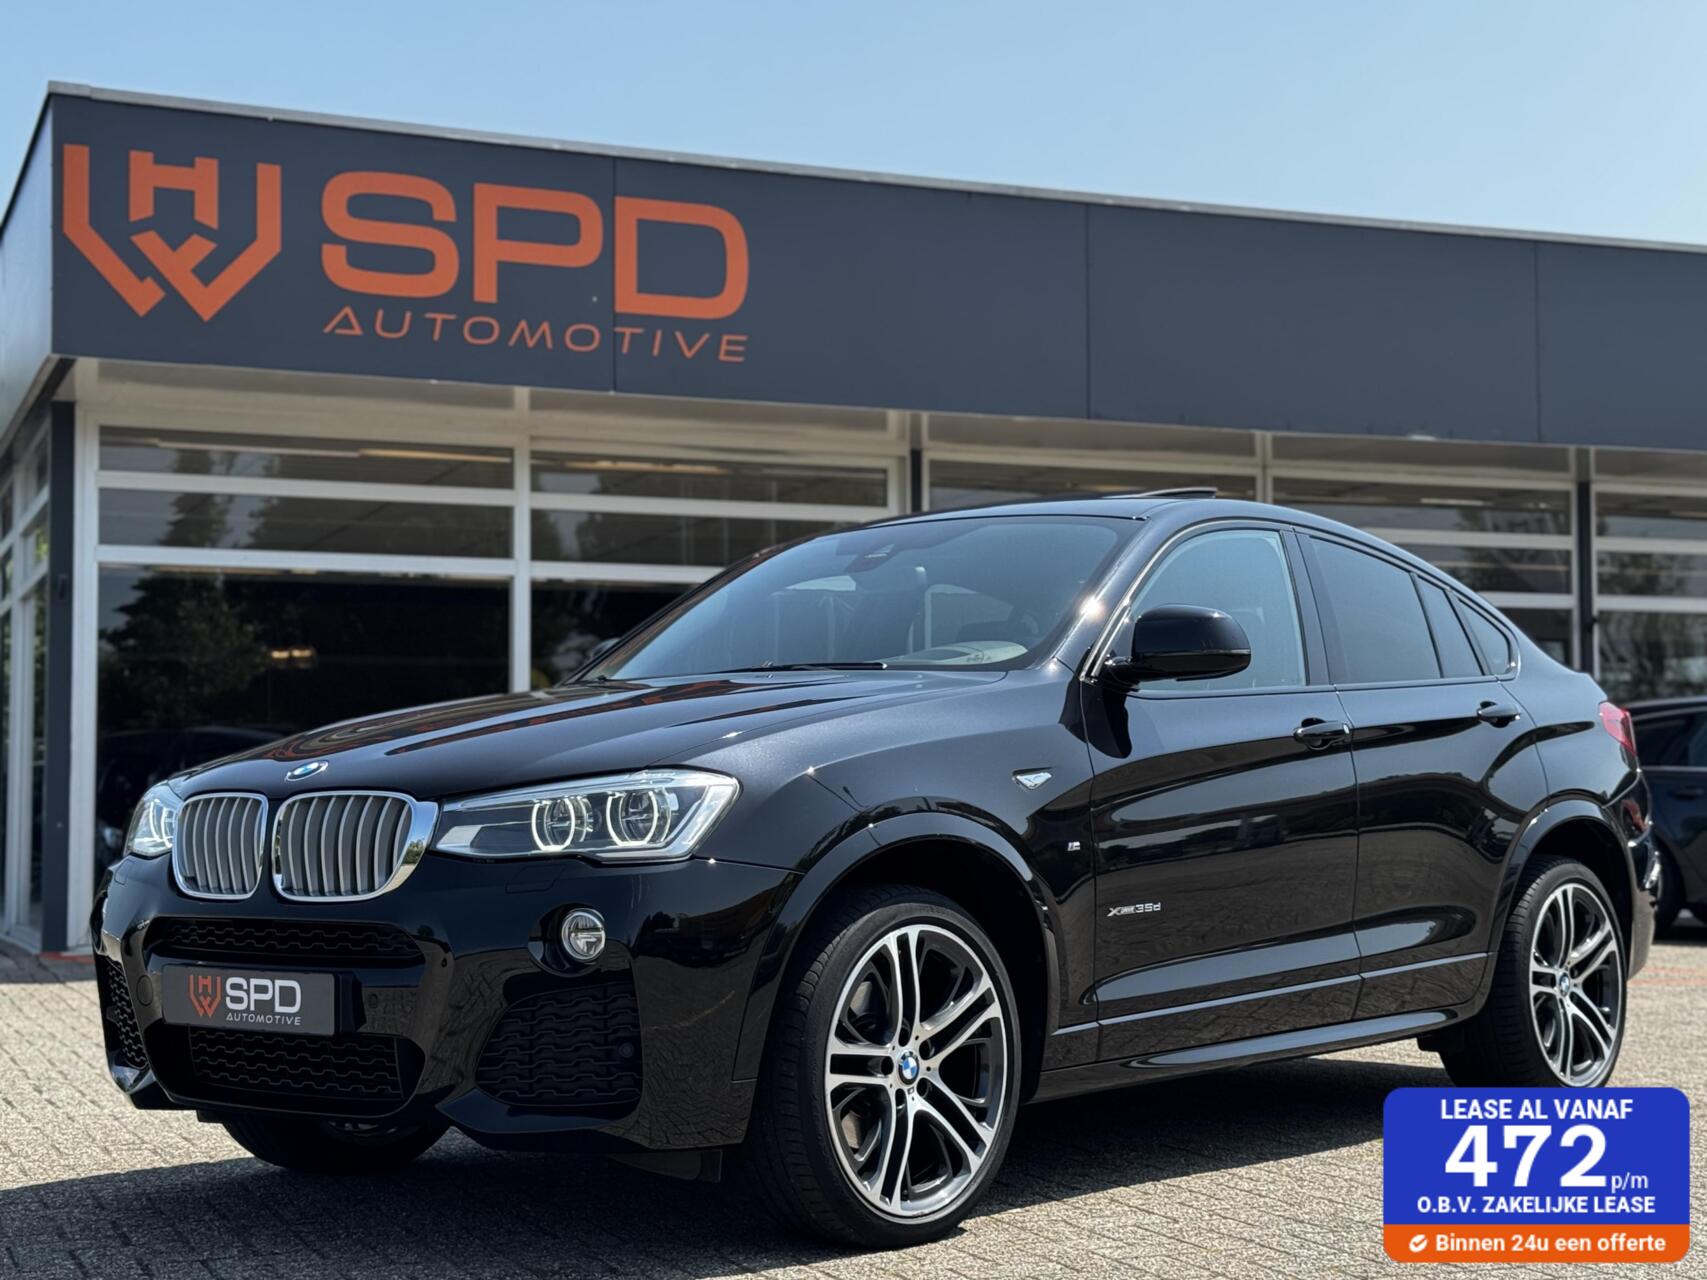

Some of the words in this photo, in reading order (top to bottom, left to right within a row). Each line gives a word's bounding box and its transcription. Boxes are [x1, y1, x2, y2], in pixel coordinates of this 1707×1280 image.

[321, 171, 749, 320] SPD
[322, 306, 748, 362] AUTOMOTIVE
[225, 976, 302, 1014] SPD
[225, 1012, 302, 1026] AUTOMOTIVE
